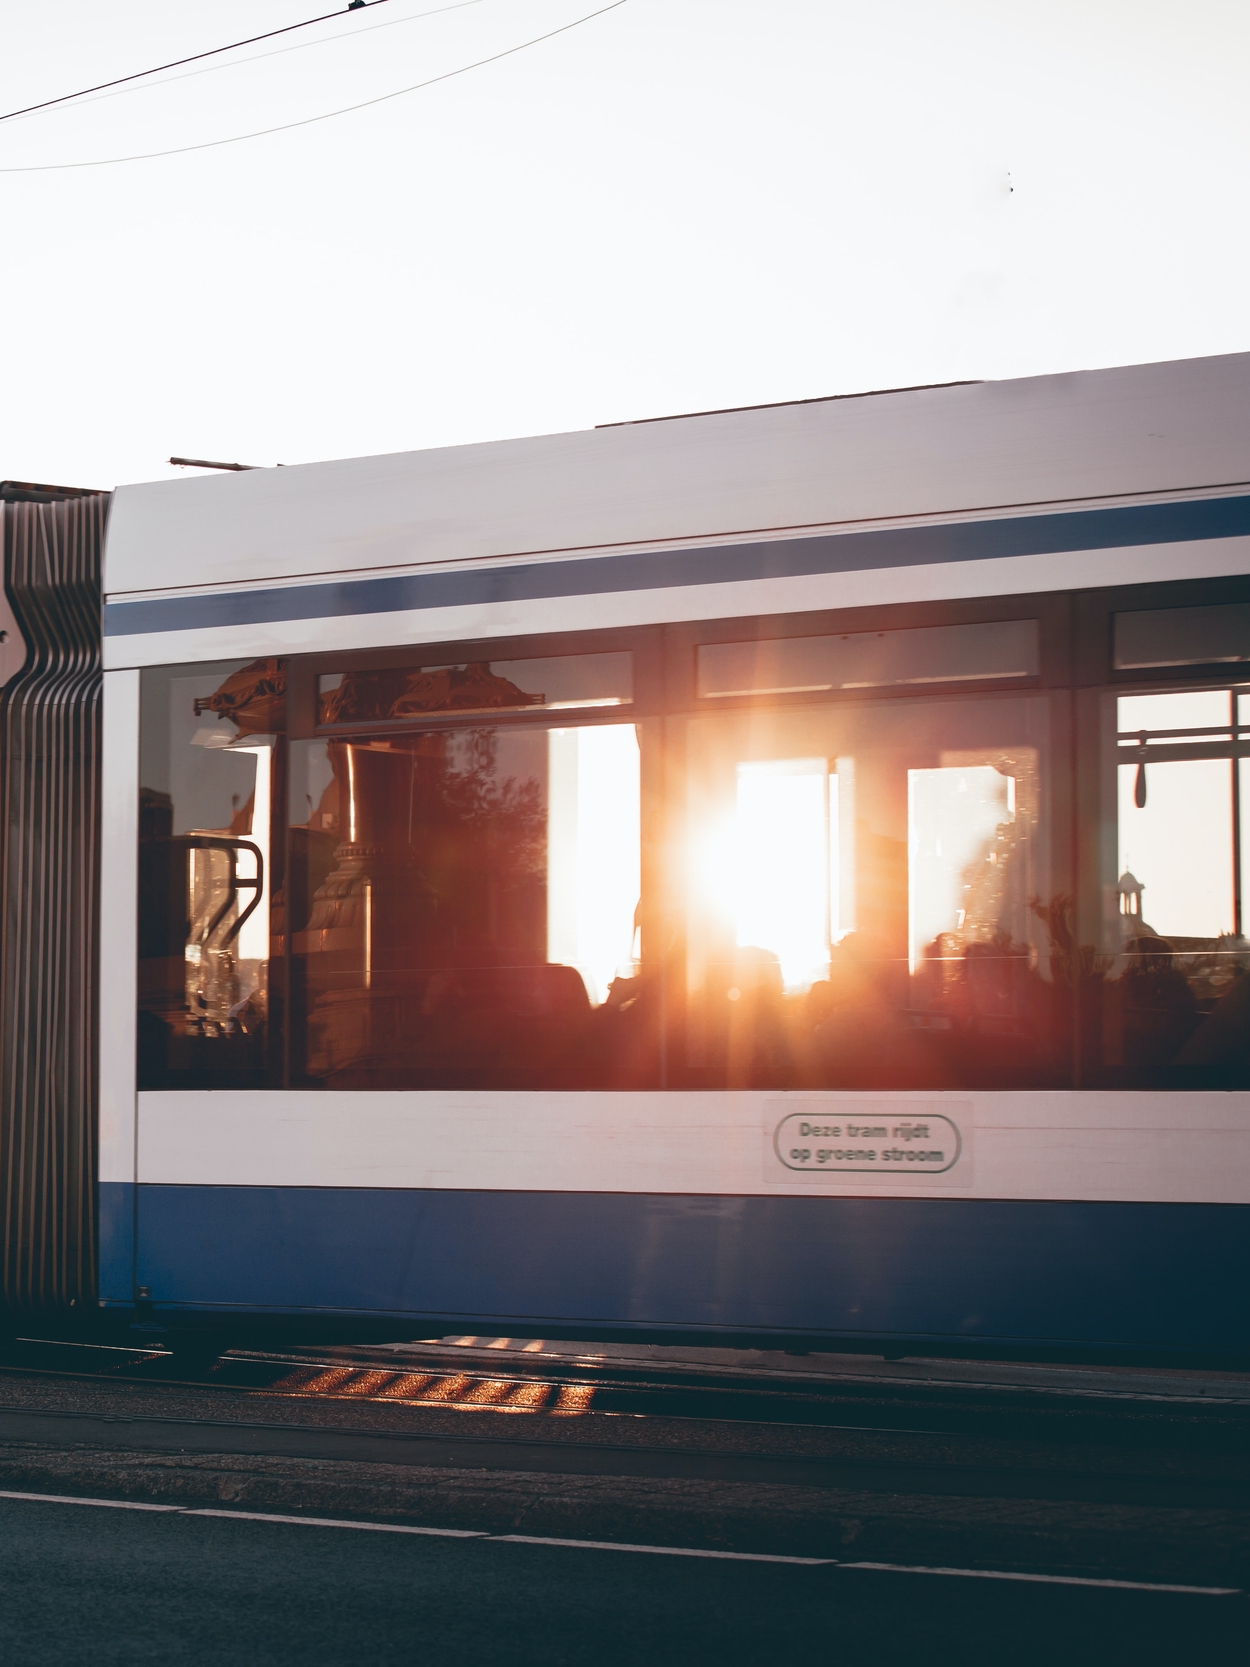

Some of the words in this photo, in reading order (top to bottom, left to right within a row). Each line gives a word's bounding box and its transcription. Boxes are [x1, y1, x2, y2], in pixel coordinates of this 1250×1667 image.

[799, 1122, 842, 1137] Deze
[846, 1123, 887, 1138] tram
[892, 1123, 930, 1141] rijdt
[789, 1148, 811, 1162] op
[816, 1148, 877, 1163] groene
[882, 1148, 944, 1162] stroom
